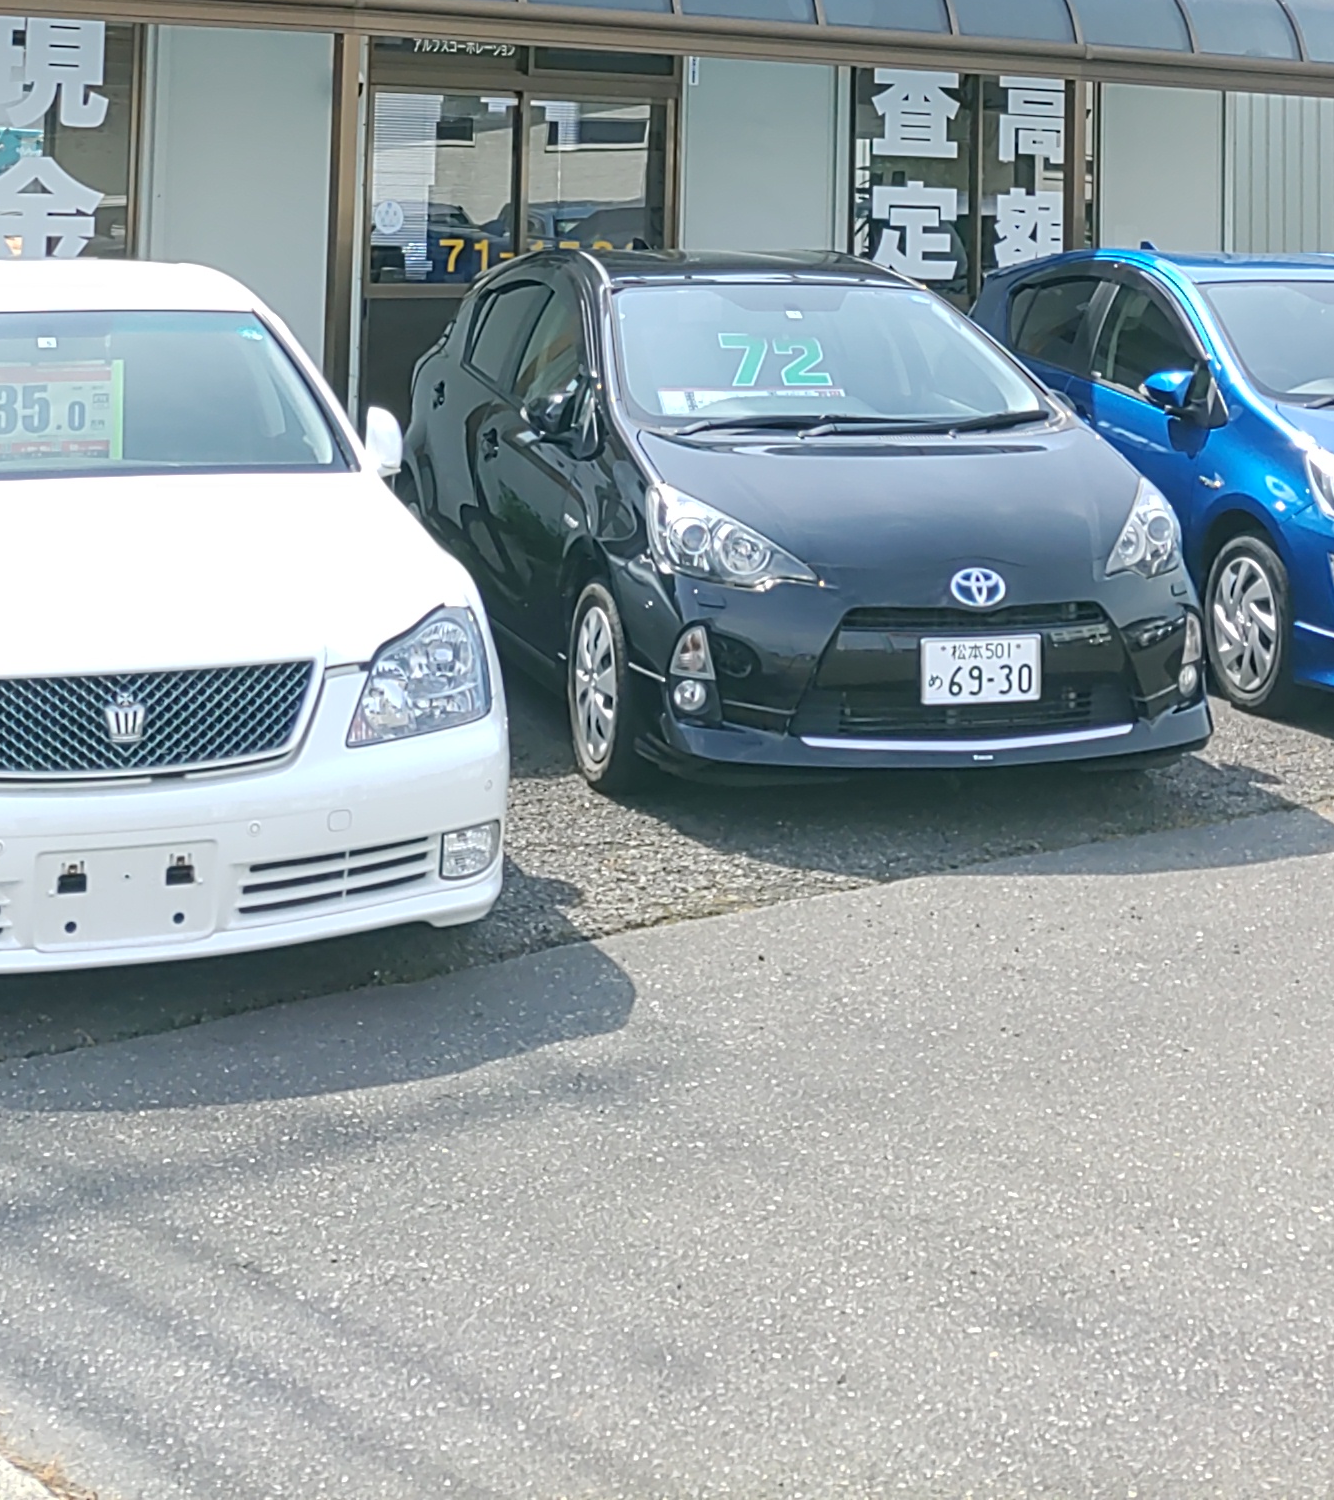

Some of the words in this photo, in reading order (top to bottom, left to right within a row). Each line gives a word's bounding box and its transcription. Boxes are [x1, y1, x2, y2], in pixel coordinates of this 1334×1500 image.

[871, 67, 961, 280] 査定
[718, 333, 833, 387] 72
[928, 673, 944, 690] め
[948, 663, 1033, 697] 69-30
